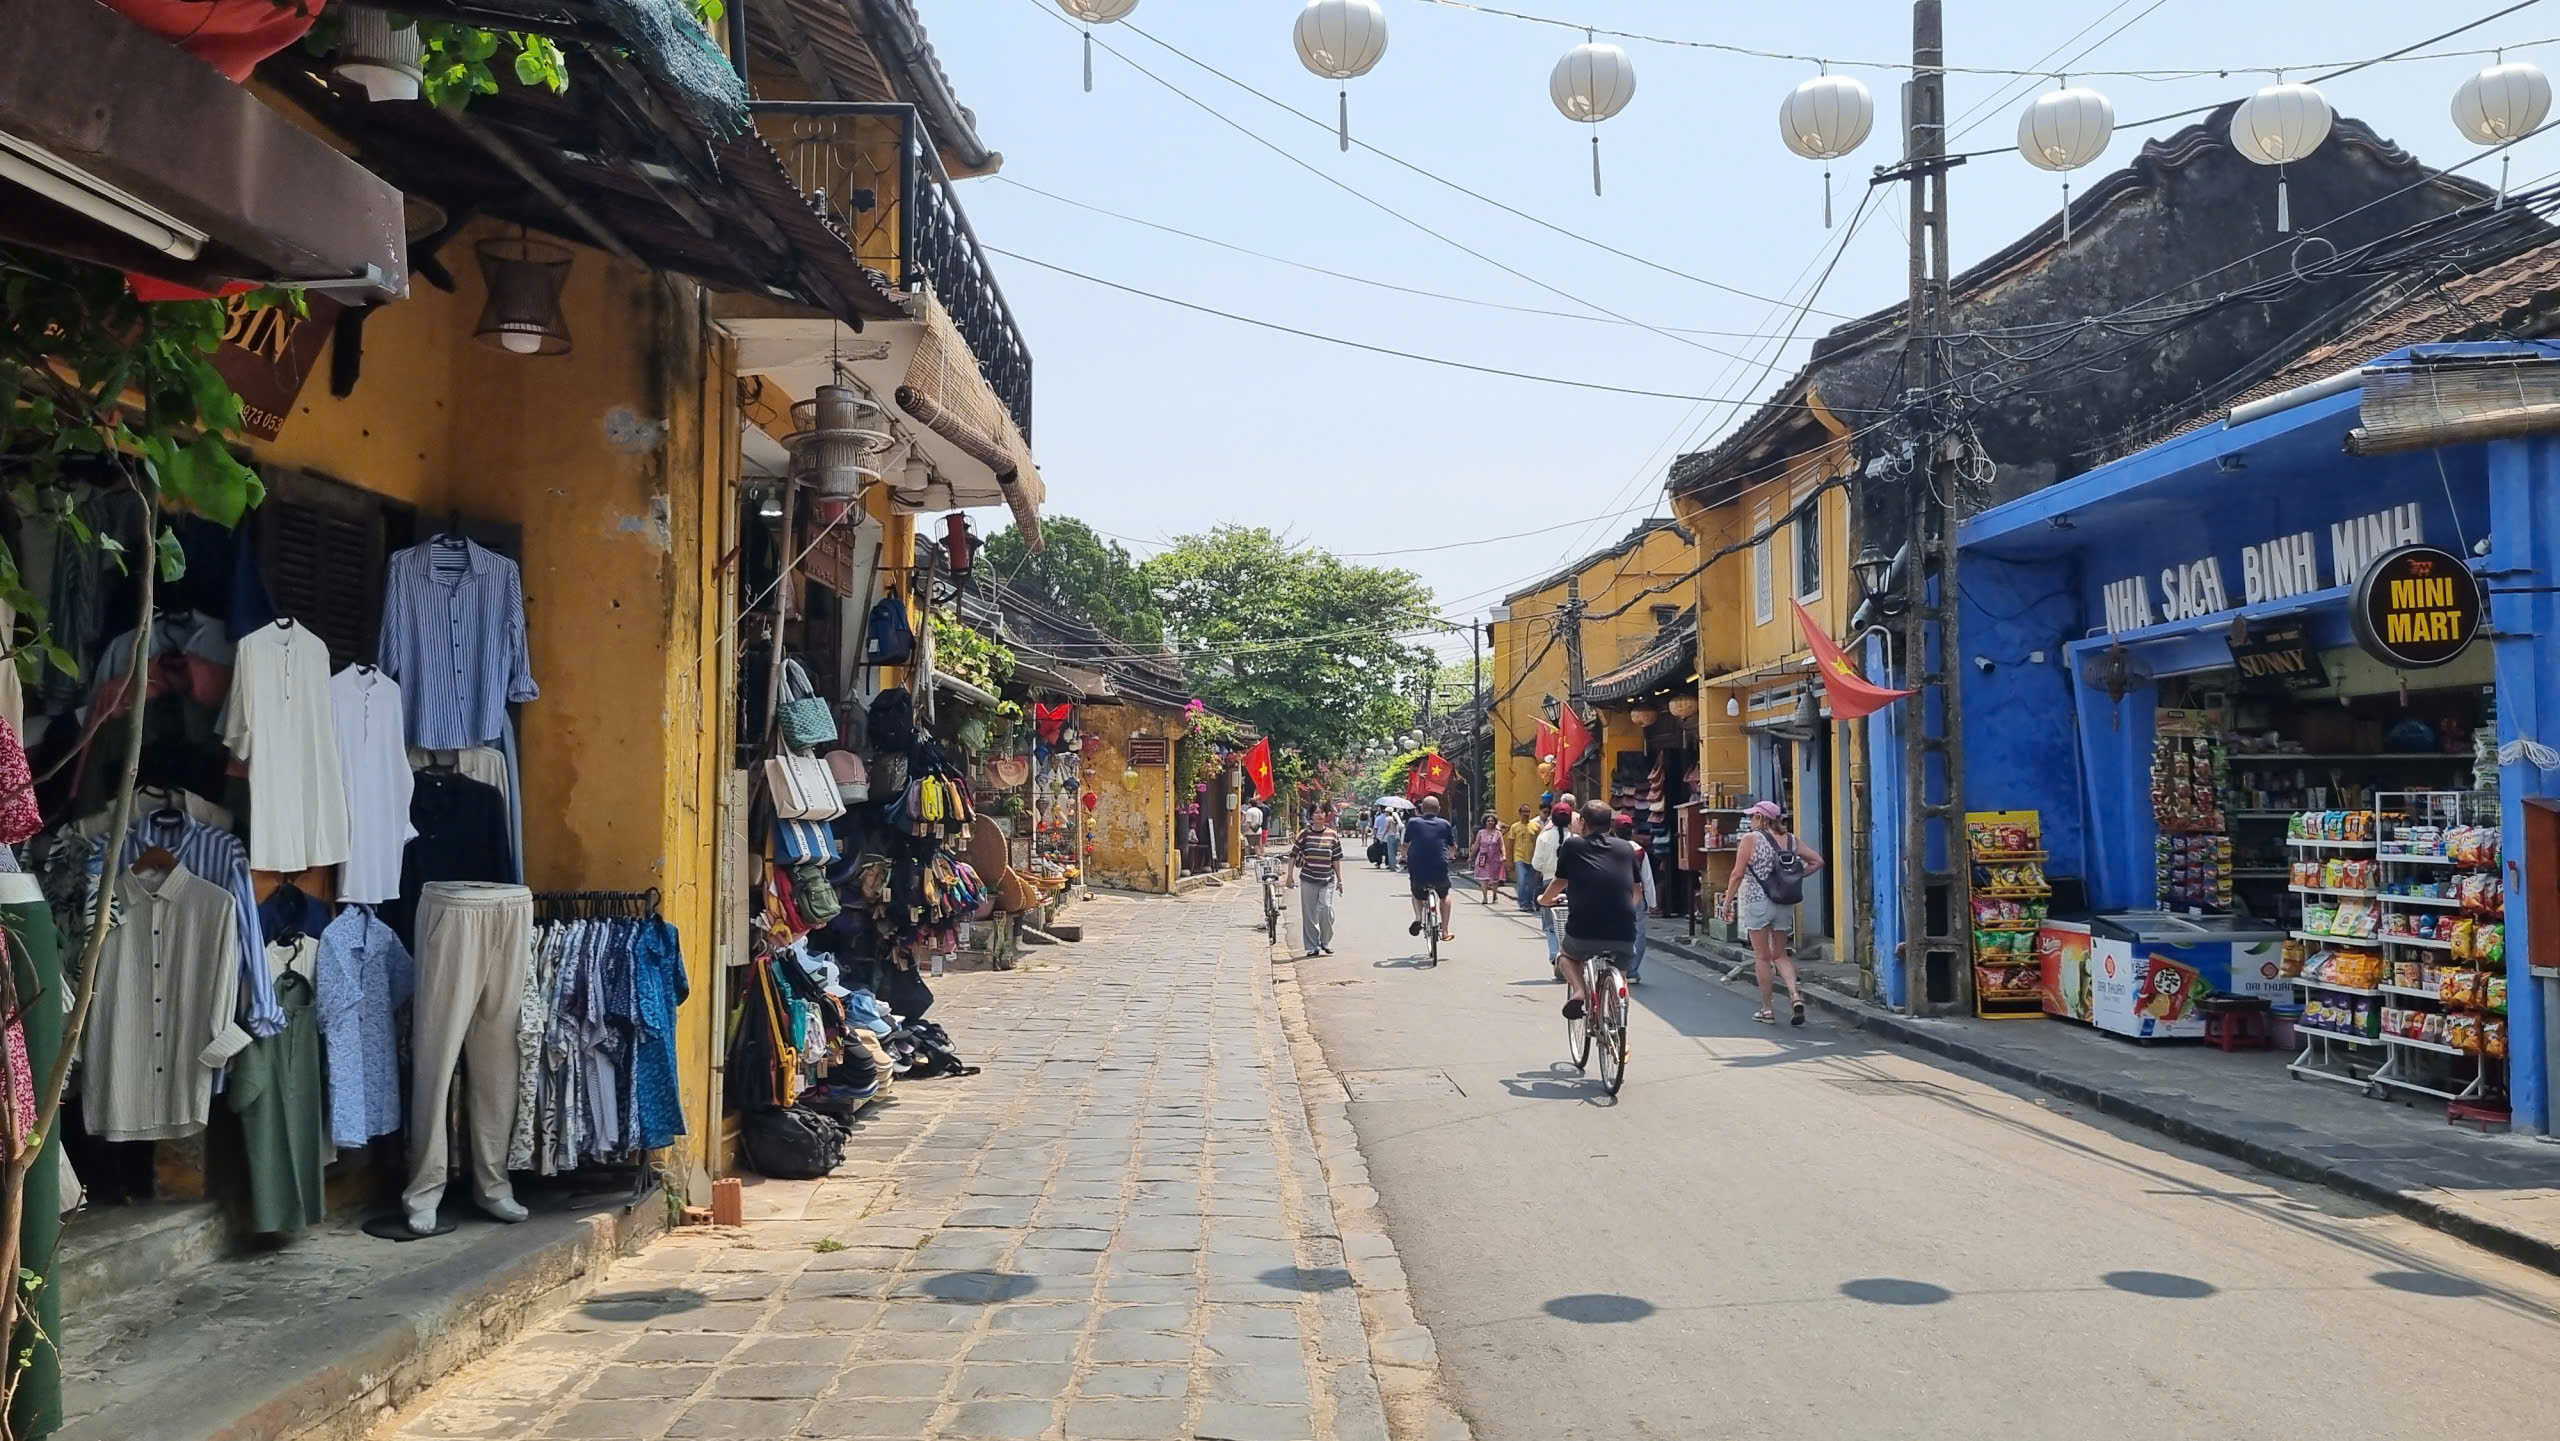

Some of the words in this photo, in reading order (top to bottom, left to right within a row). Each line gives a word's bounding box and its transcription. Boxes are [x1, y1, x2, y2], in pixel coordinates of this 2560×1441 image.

[262, 413, 284, 432] 053
[2103, 575, 2154, 634] NHA
[2161, 556, 2228, 622] SACH
[2242, 531, 2318, 606] BINH
[2331, 502, 2424, 587] MINH
[2391, 577, 2454, 609] MINI
[2387, 611, 2462, 643] MART
[2240, 648, 2307, 678] SUNNY
